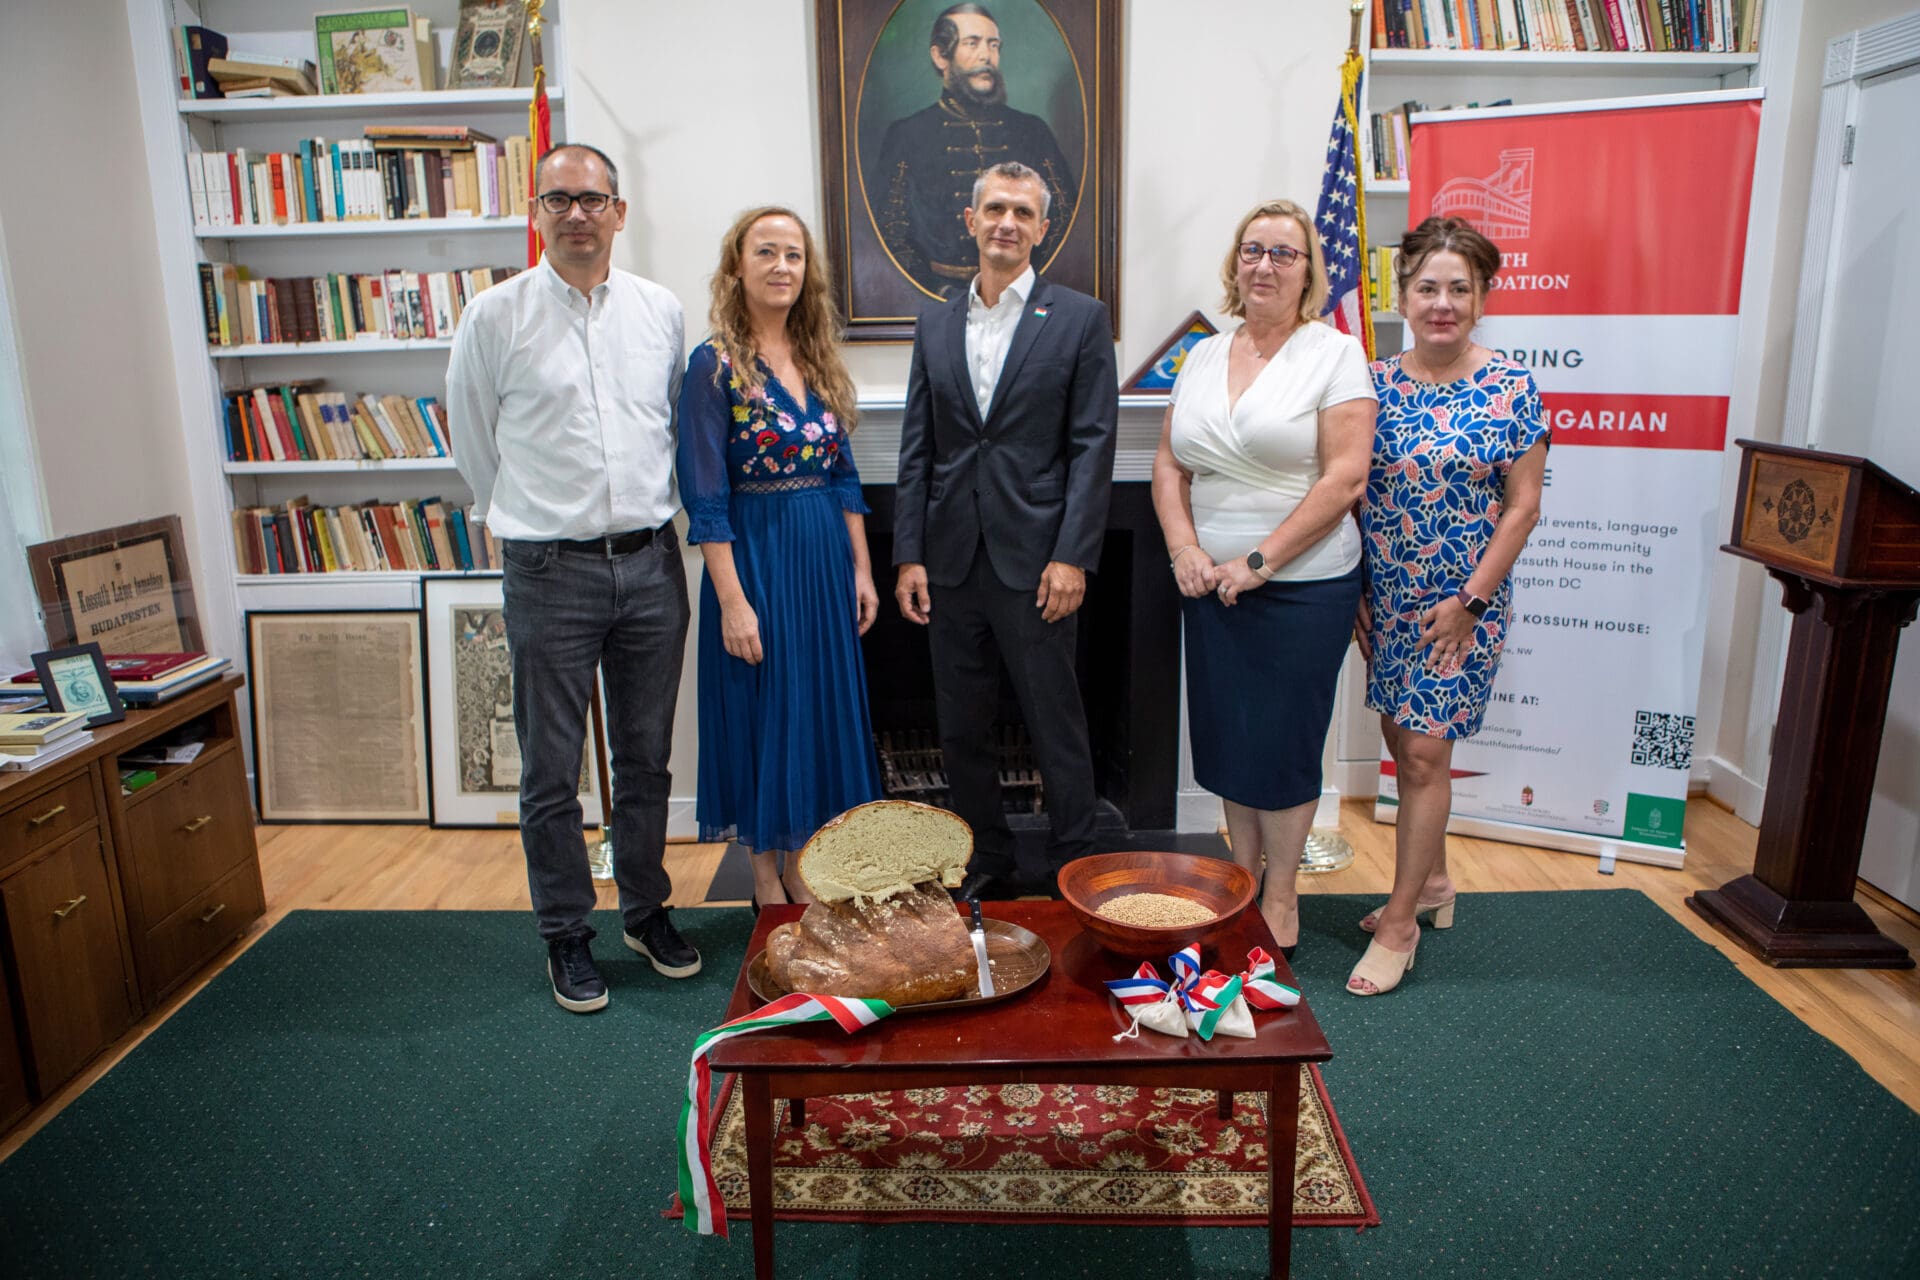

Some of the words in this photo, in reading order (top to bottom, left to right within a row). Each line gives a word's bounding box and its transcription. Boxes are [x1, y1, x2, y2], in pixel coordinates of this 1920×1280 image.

[1552, 519, 1602, 532] events,
[1607, 520, 1678, 537] language
[1538, 538, 1566, 549] and
[1570, 540, 1651, 557] community
[1563, 558, 1607, 572] House
[1612, 561, 1625, 573] in
[1631, 562, 1653, 575] the
[1559, 577, 1582, 590] DC
[91, 602, 162, 636] BUDAPESTEN
[1523, 614, 1588, 629] KOSSUTH
[1594, 620, 1650, 634] HOUSE:
[1517, 647, 1534, 656] NW
[1521, 695, 1540, 706] AT:
